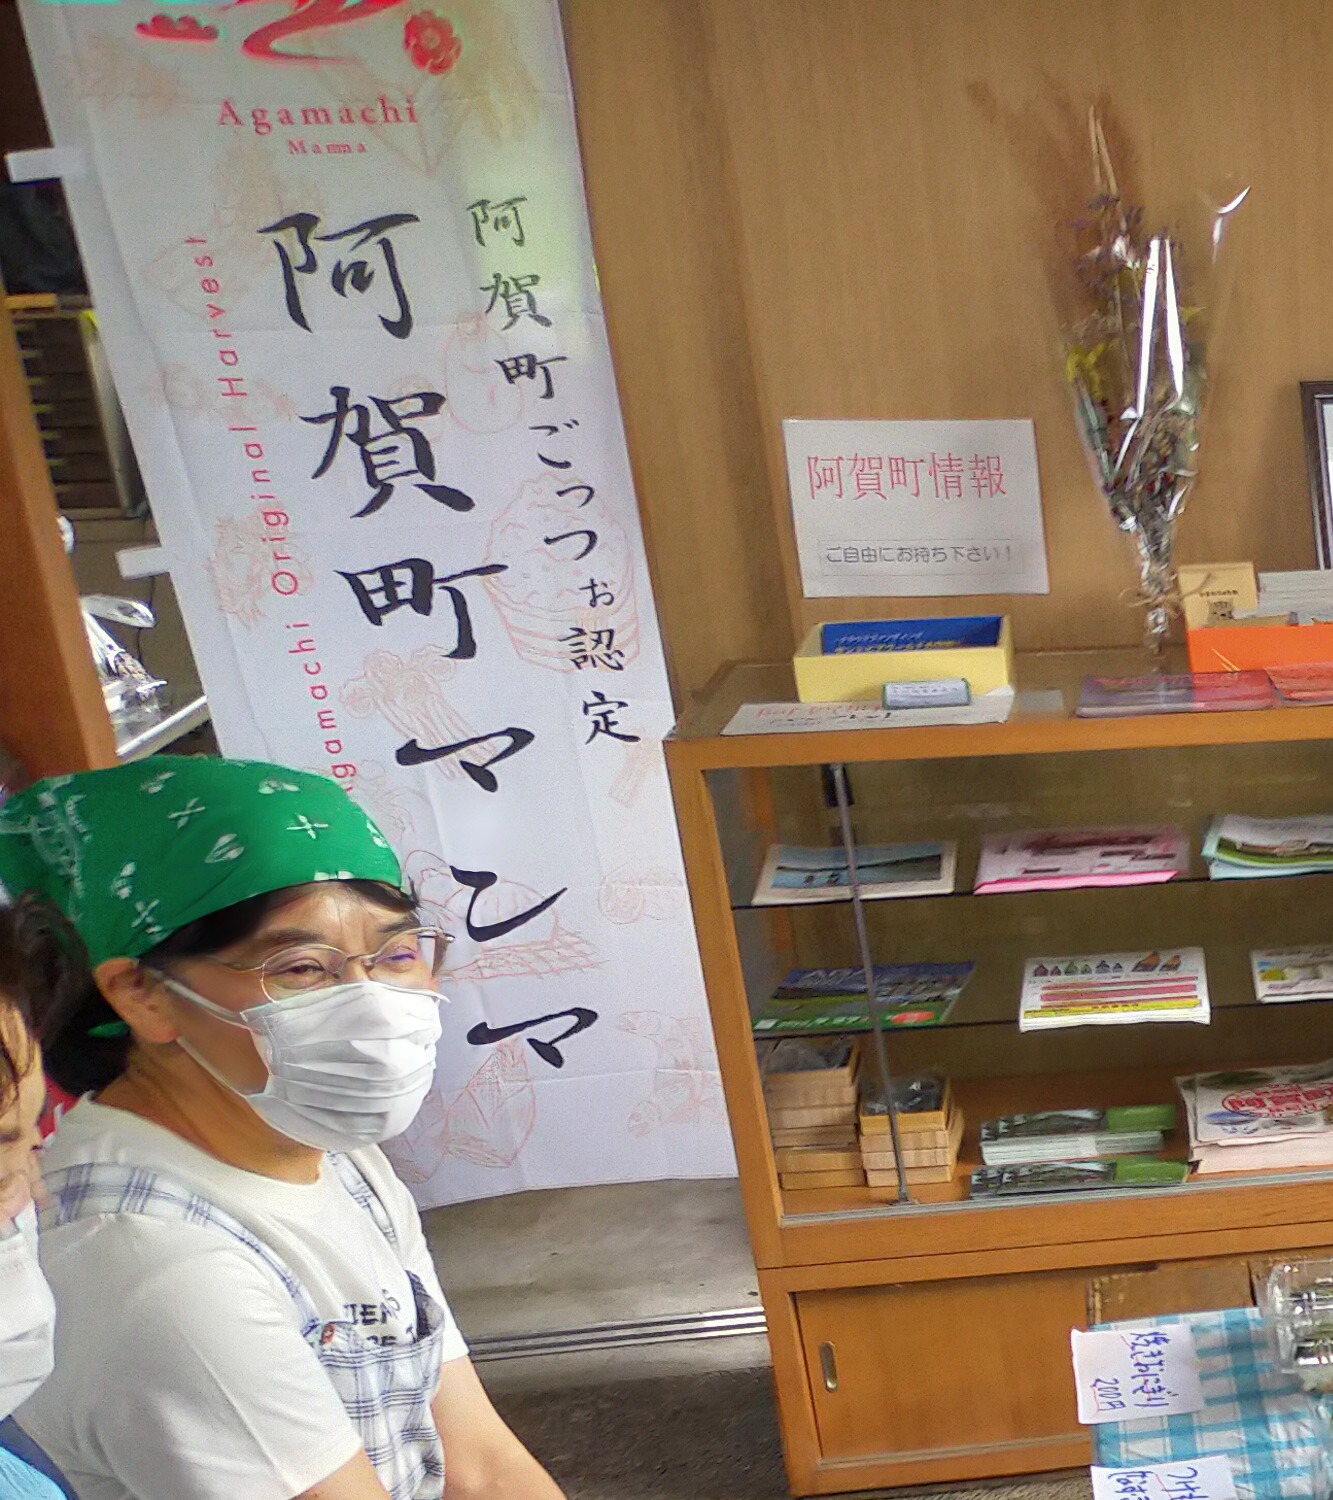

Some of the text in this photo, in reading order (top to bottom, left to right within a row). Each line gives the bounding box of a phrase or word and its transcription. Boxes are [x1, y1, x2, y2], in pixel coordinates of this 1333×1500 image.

[217, 94, 418, 135] Agamachi
[807, 452, 1007, 500] 阿賀町情報
[187, 236, 360, 792] gamachi Original Harvest
